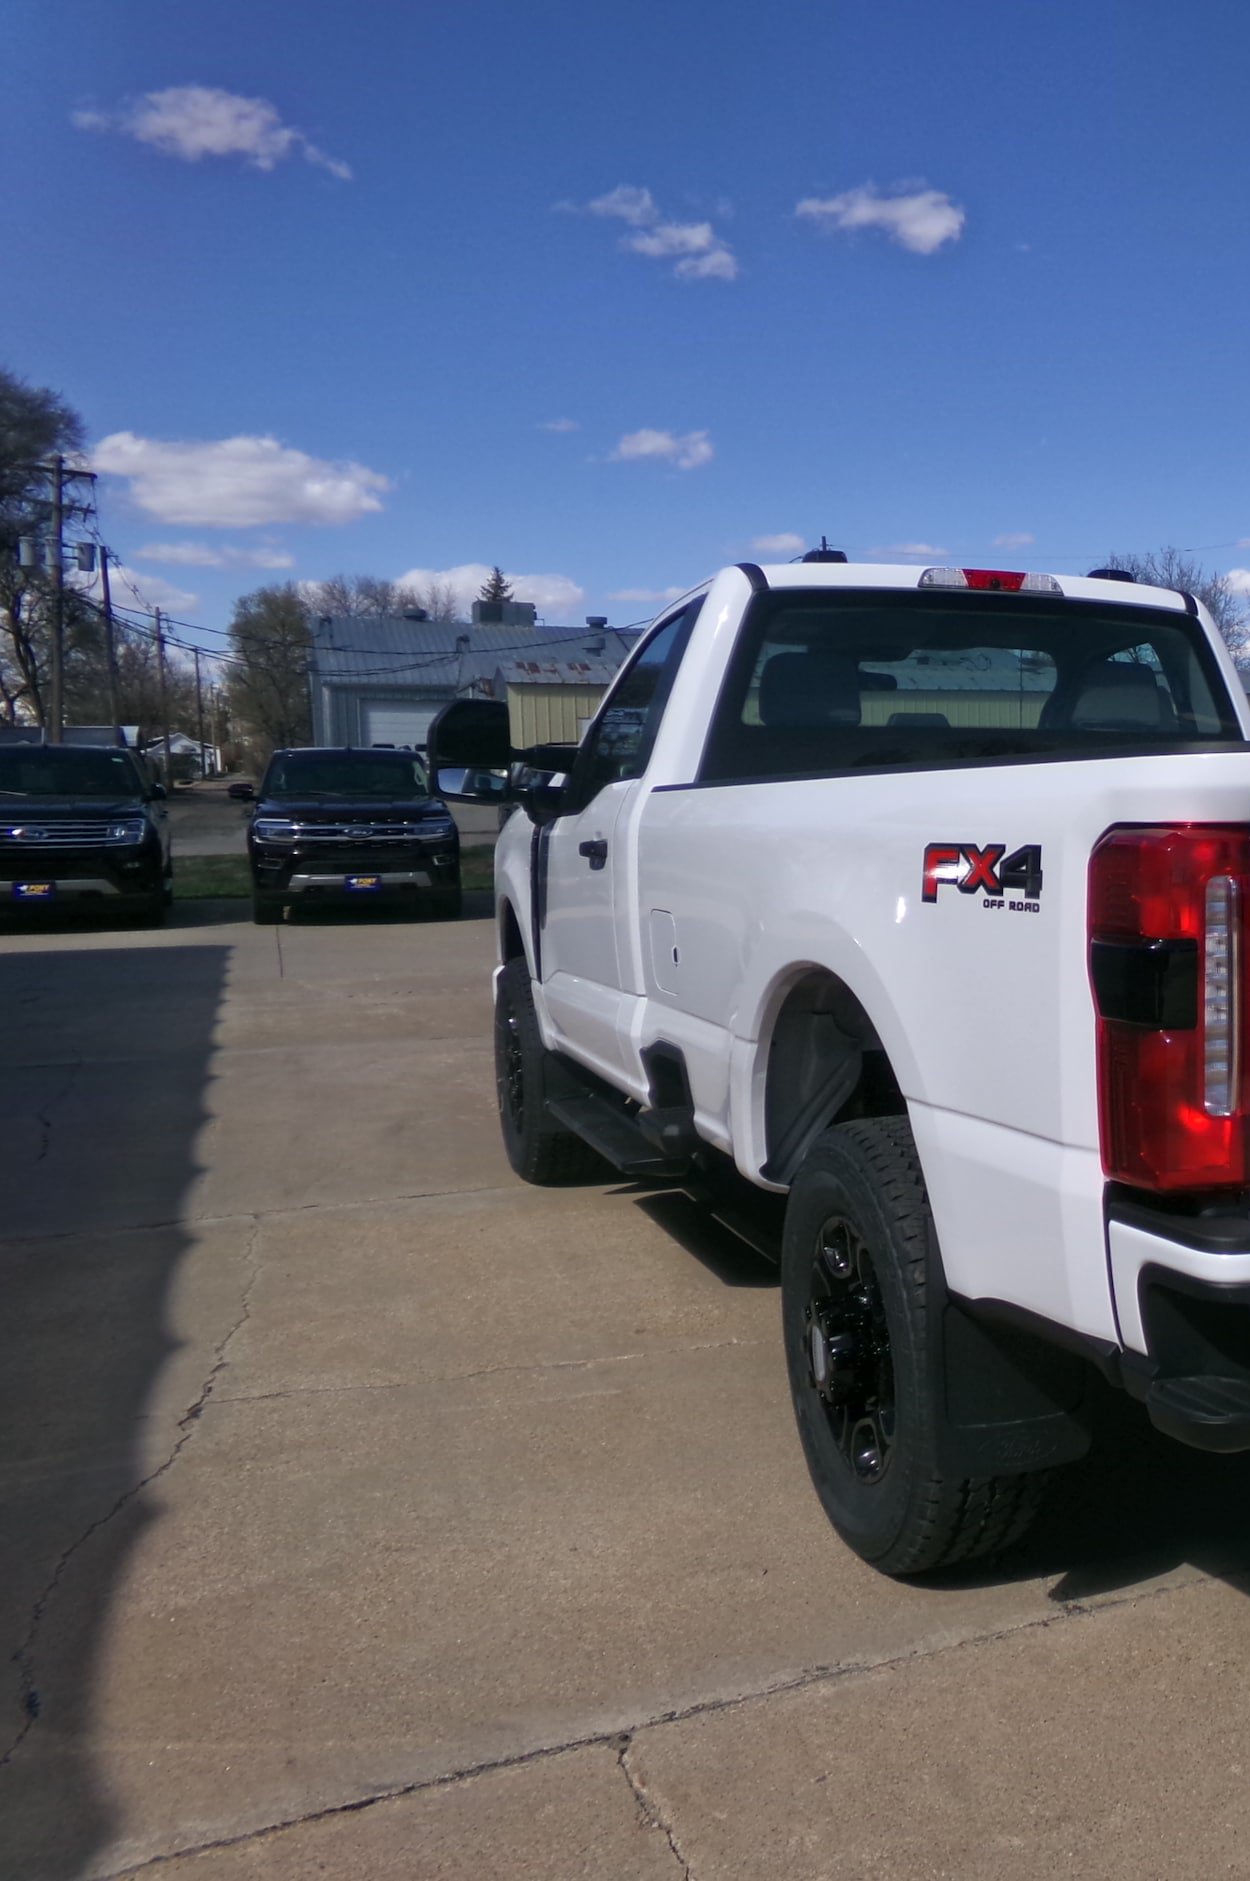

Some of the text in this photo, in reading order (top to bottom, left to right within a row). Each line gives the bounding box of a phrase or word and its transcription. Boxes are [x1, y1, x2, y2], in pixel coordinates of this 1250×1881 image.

[922, 842, 1043, 904] FX4
[983, 898, 1040, 913] OFF ROAD
